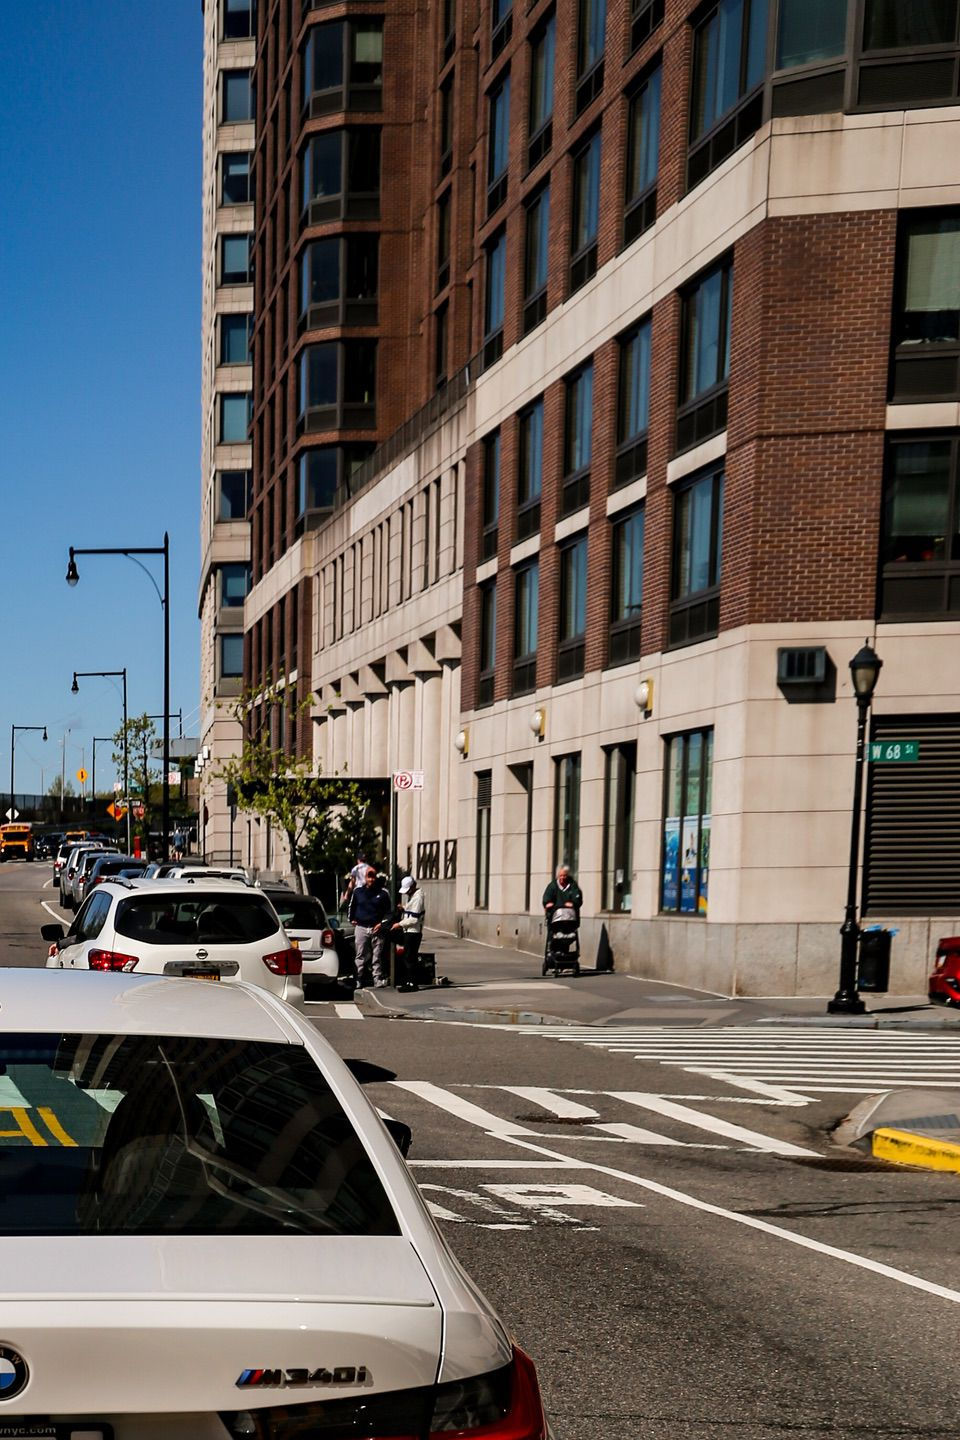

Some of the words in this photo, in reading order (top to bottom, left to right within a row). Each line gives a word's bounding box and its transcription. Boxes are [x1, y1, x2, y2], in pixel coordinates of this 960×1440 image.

[872, 745, 882, 759] W
[886, 744, 901, 759] 68
[260, 1366, 367, 1385] M340i
